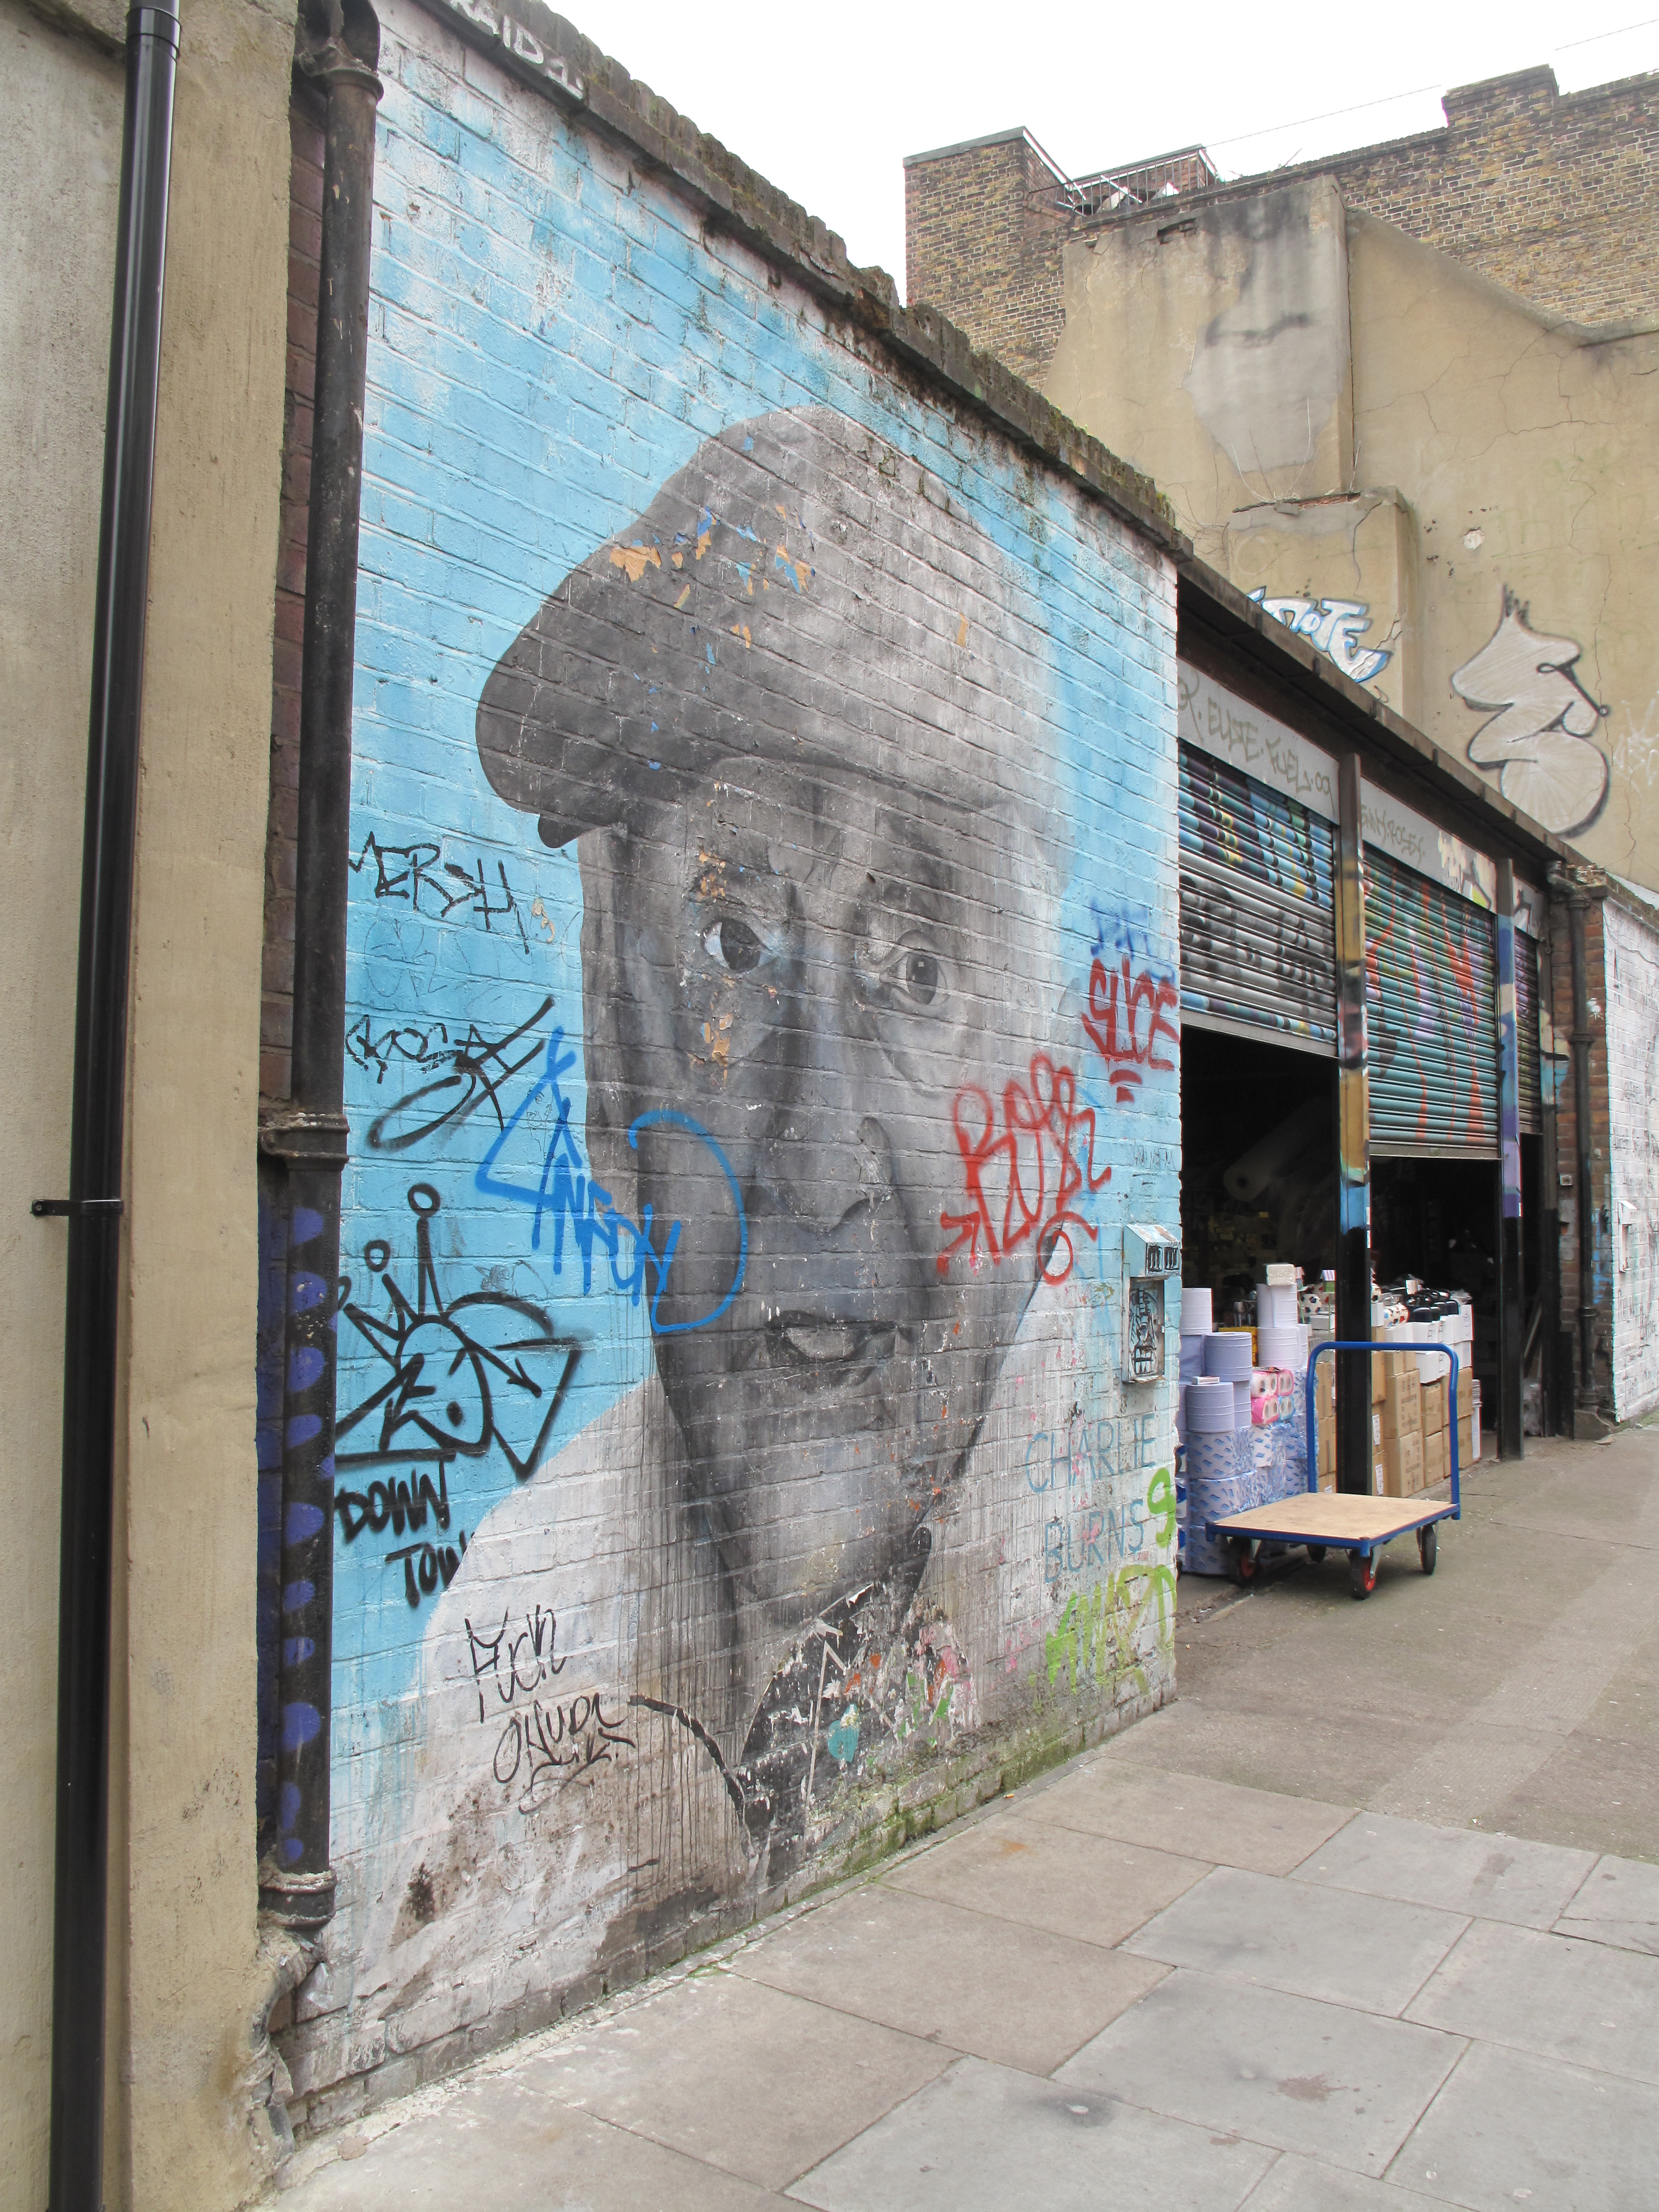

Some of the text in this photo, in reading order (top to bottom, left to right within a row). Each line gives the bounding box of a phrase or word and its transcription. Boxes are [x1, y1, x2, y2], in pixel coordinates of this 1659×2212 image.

[1025, 1414, 1156, 1494] CHARLIE
[334, 1460, 450, 1543] DOWN
[1044, 1498, 1144, 1584] BURNS
